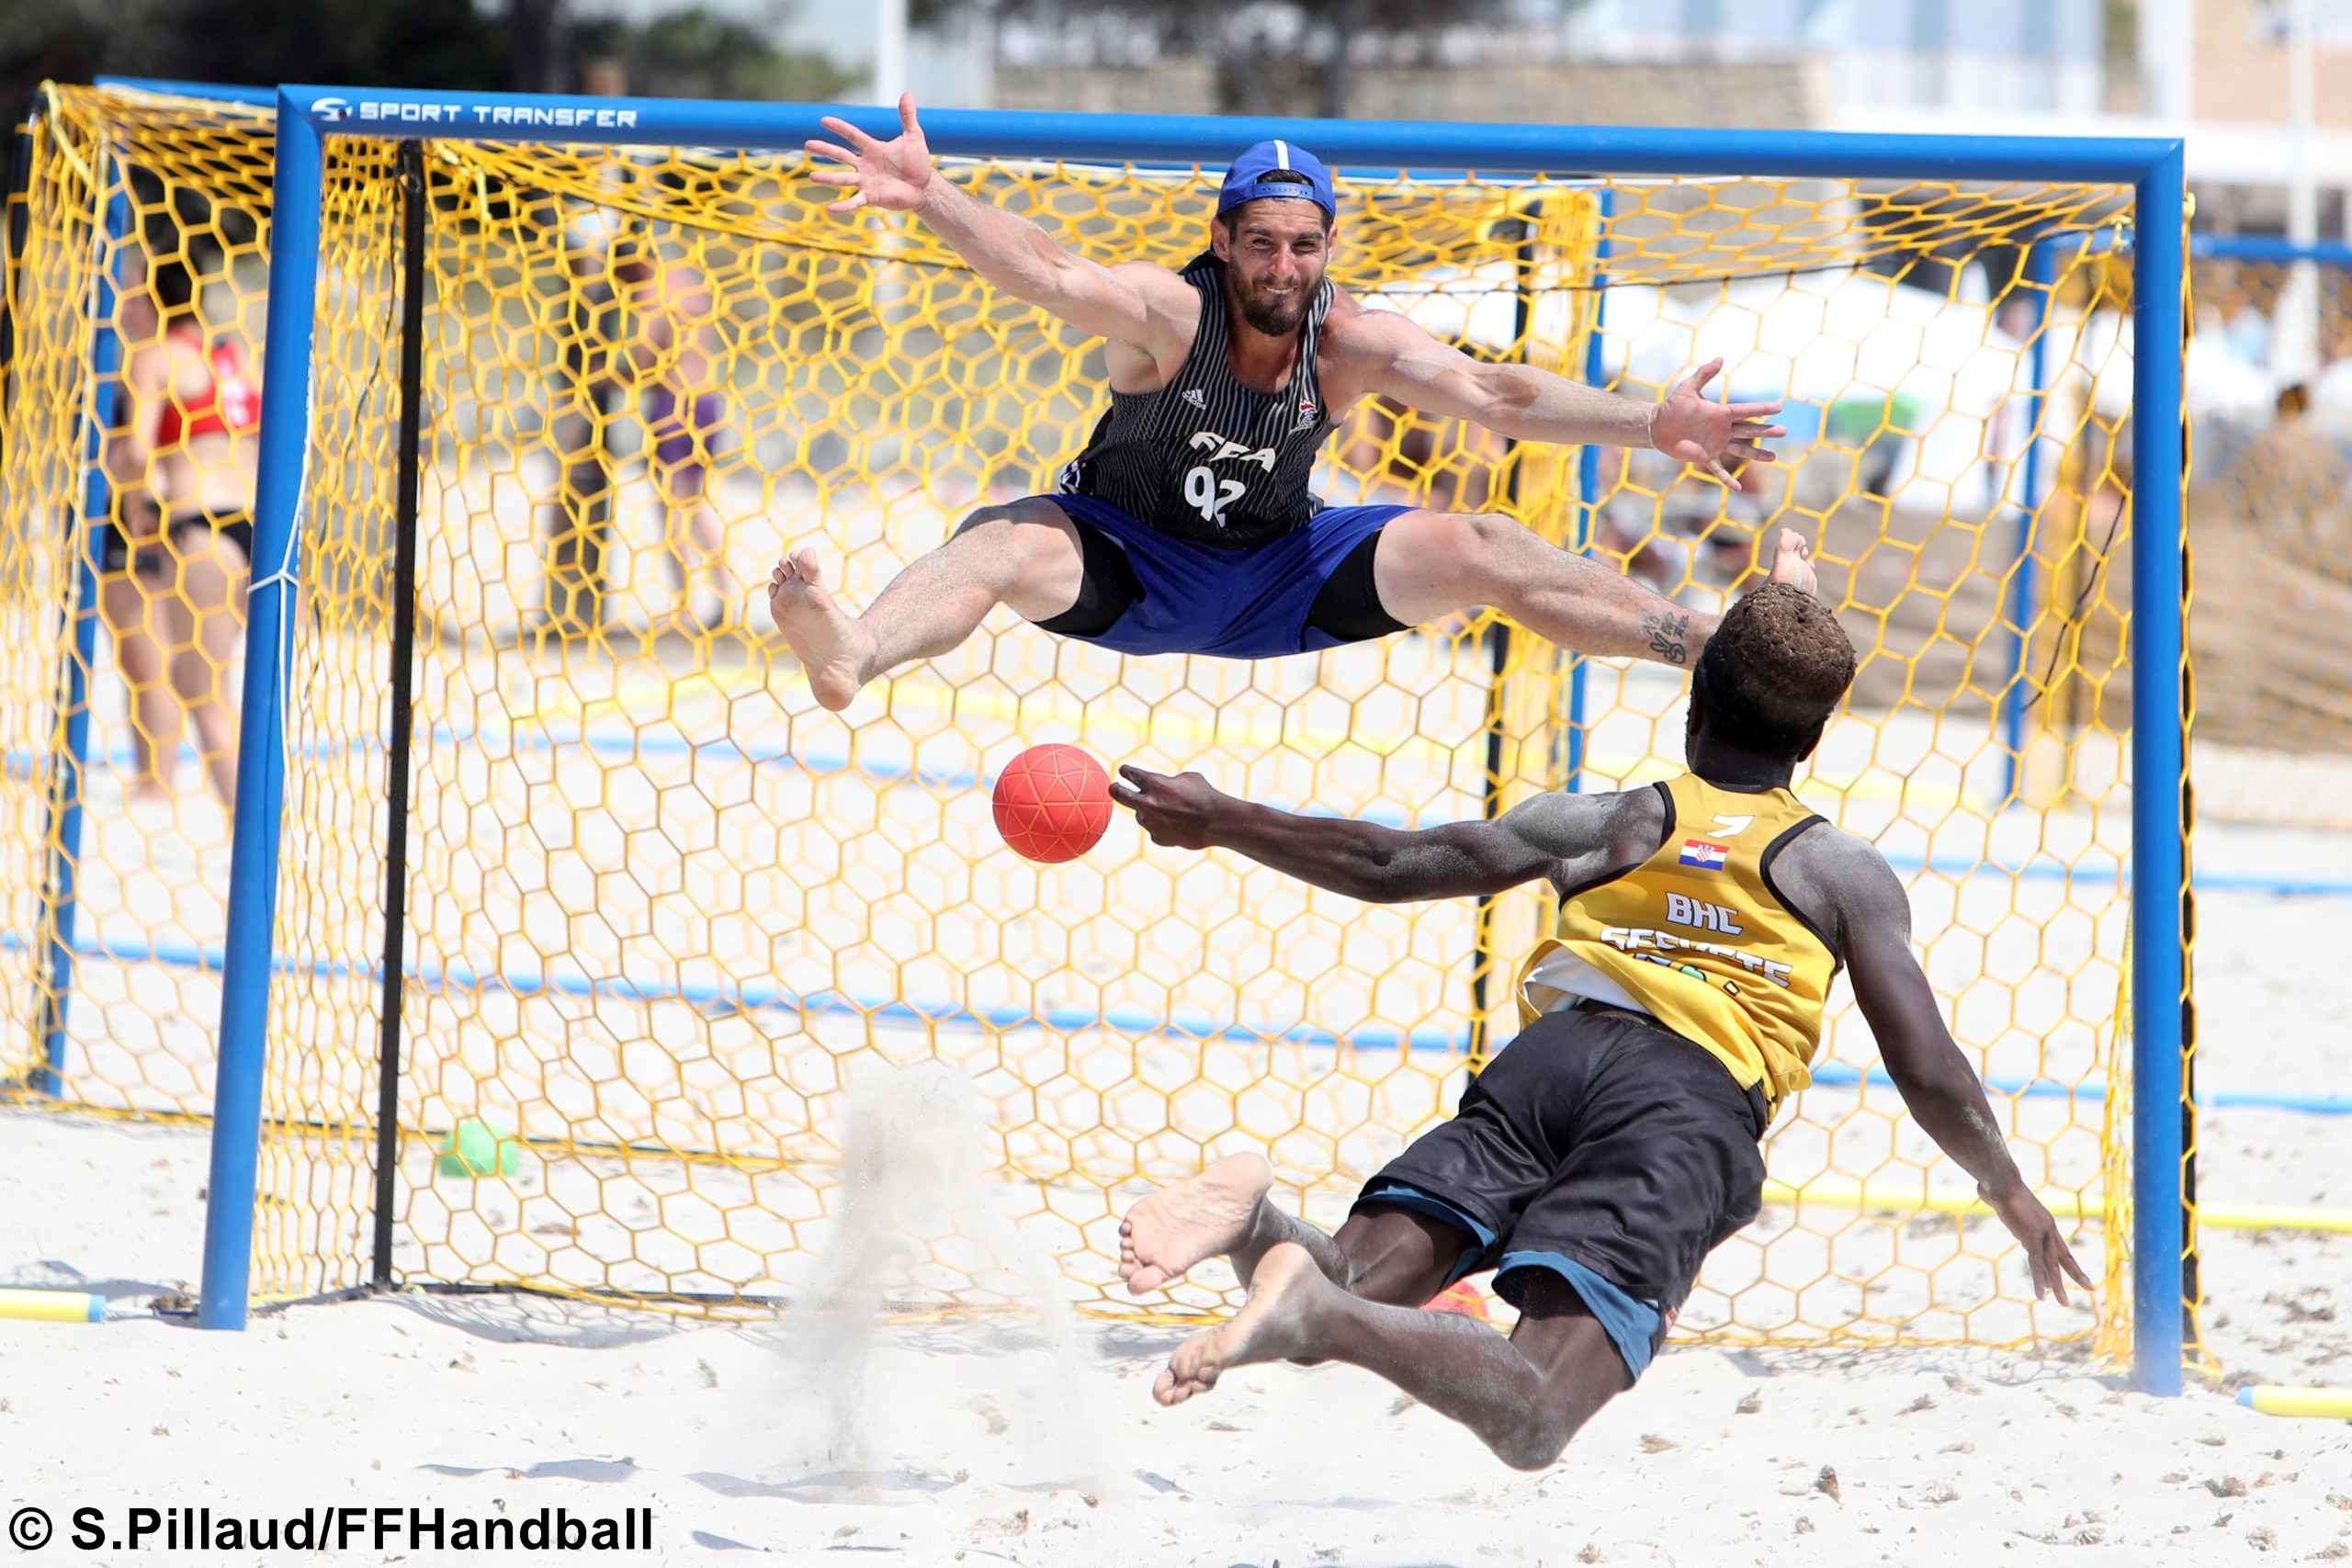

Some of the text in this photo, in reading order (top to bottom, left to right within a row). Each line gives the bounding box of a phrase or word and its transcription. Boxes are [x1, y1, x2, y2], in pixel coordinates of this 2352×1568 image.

[359, 101, 461, 123] SPORT
[472, 105, 639, 129] TRANSFER
[1184, 466, 1246, 529] 92
[1704, 813, 1757, 840] 7
[1665, 891, 1744, 935] BHC
